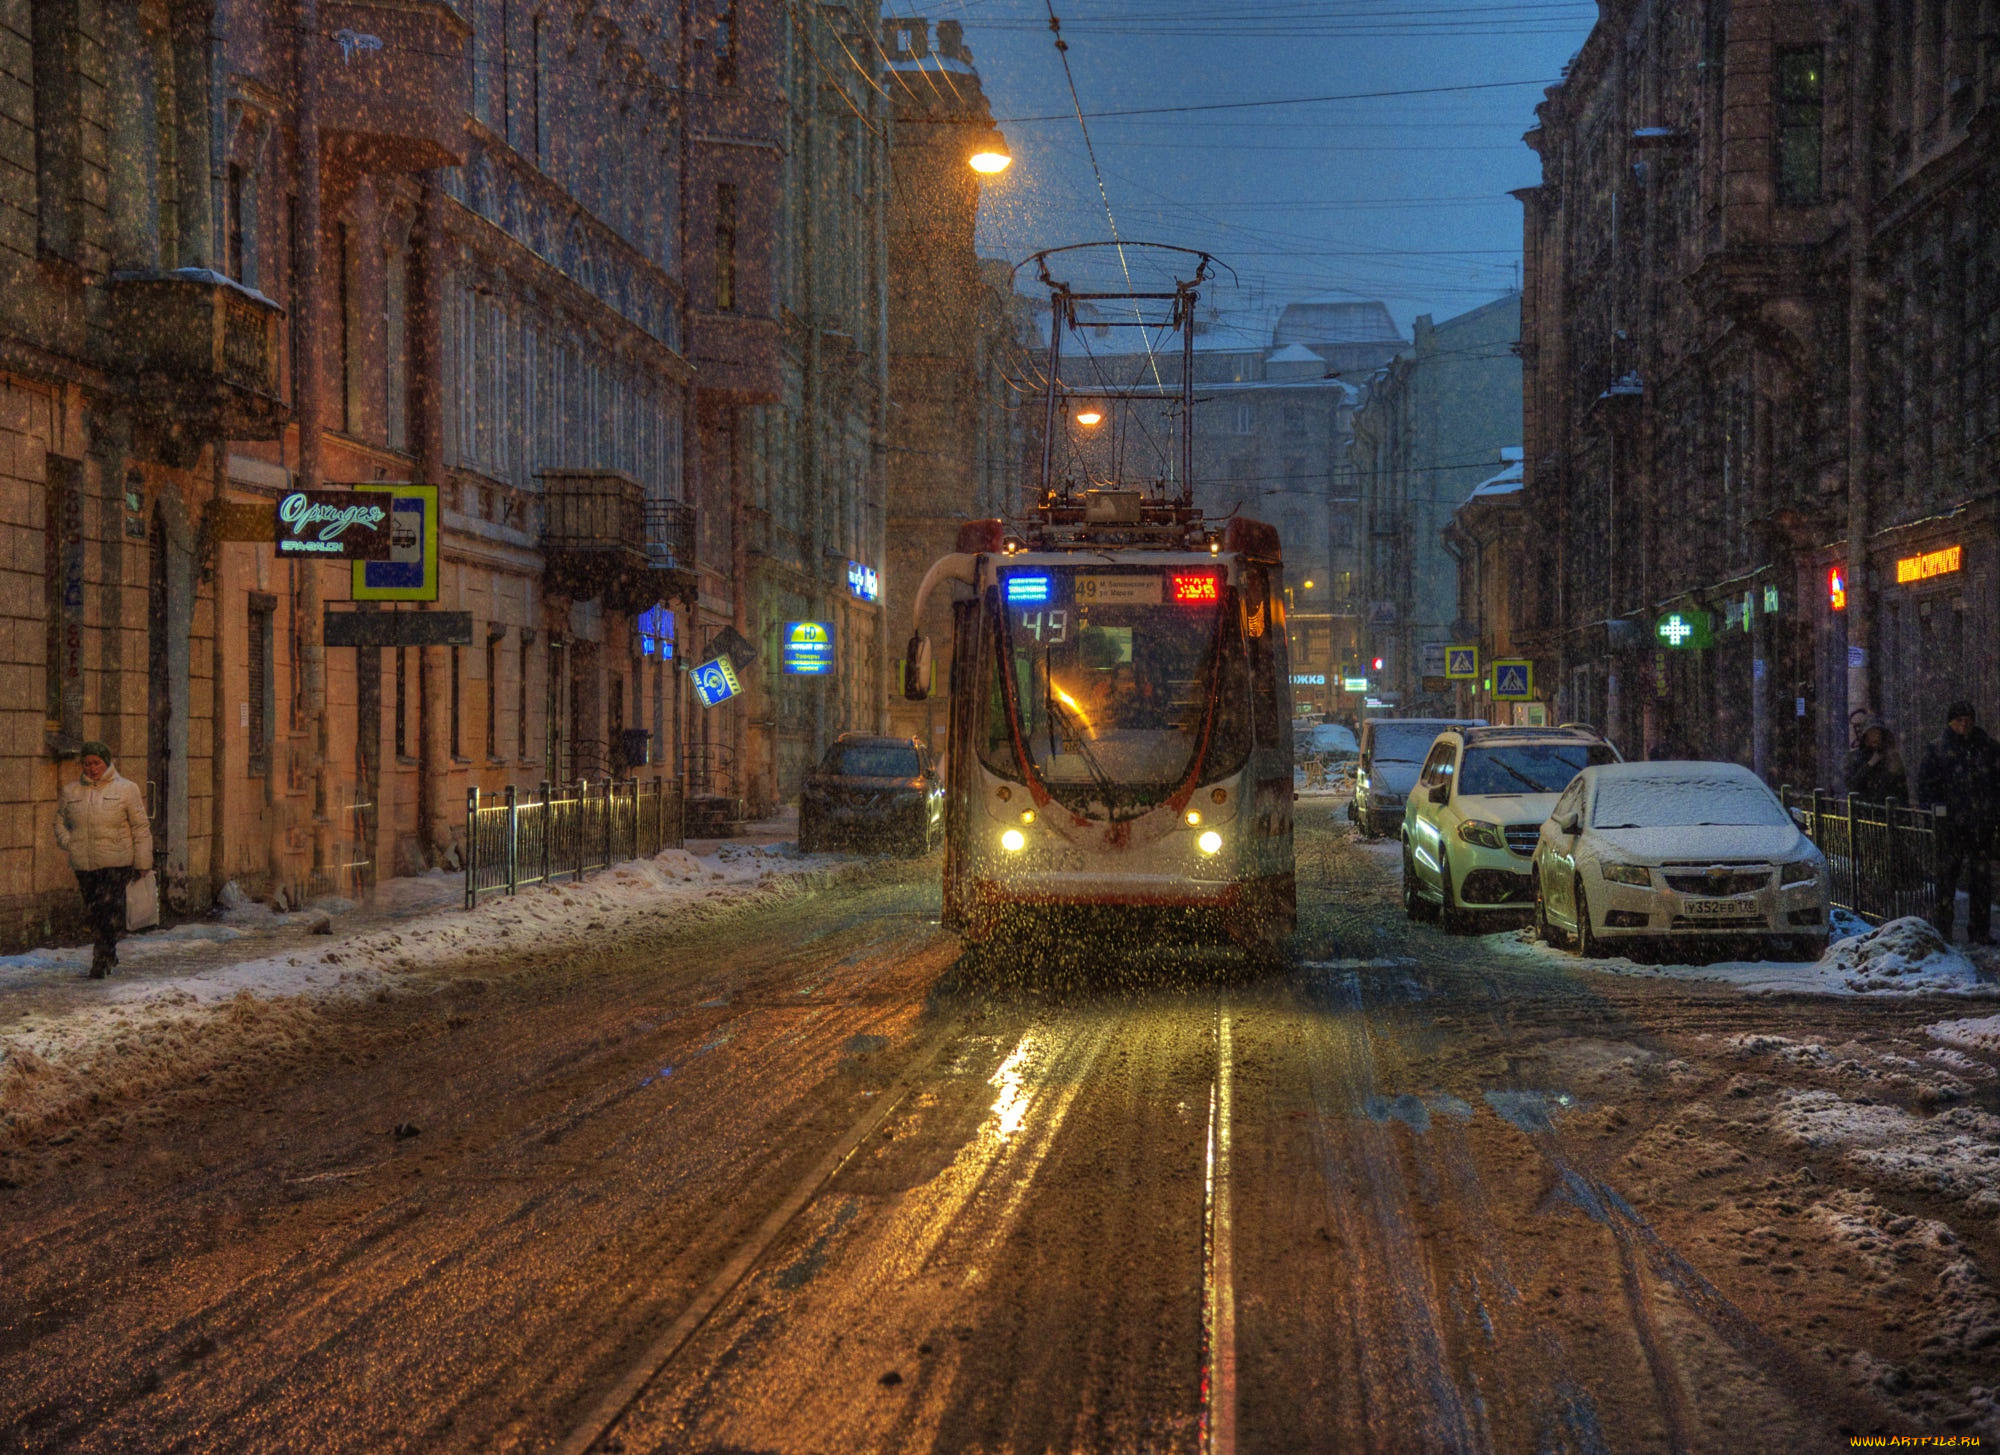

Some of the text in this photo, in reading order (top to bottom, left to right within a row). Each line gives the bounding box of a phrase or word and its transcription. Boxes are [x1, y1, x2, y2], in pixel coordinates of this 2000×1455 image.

[280, 492, 386, 541] Орхидея
[1076, 580, 1096, 598] 49
[1023, 610, 1067, 643] 49
[1288, 674, 1325, 685] ожка
